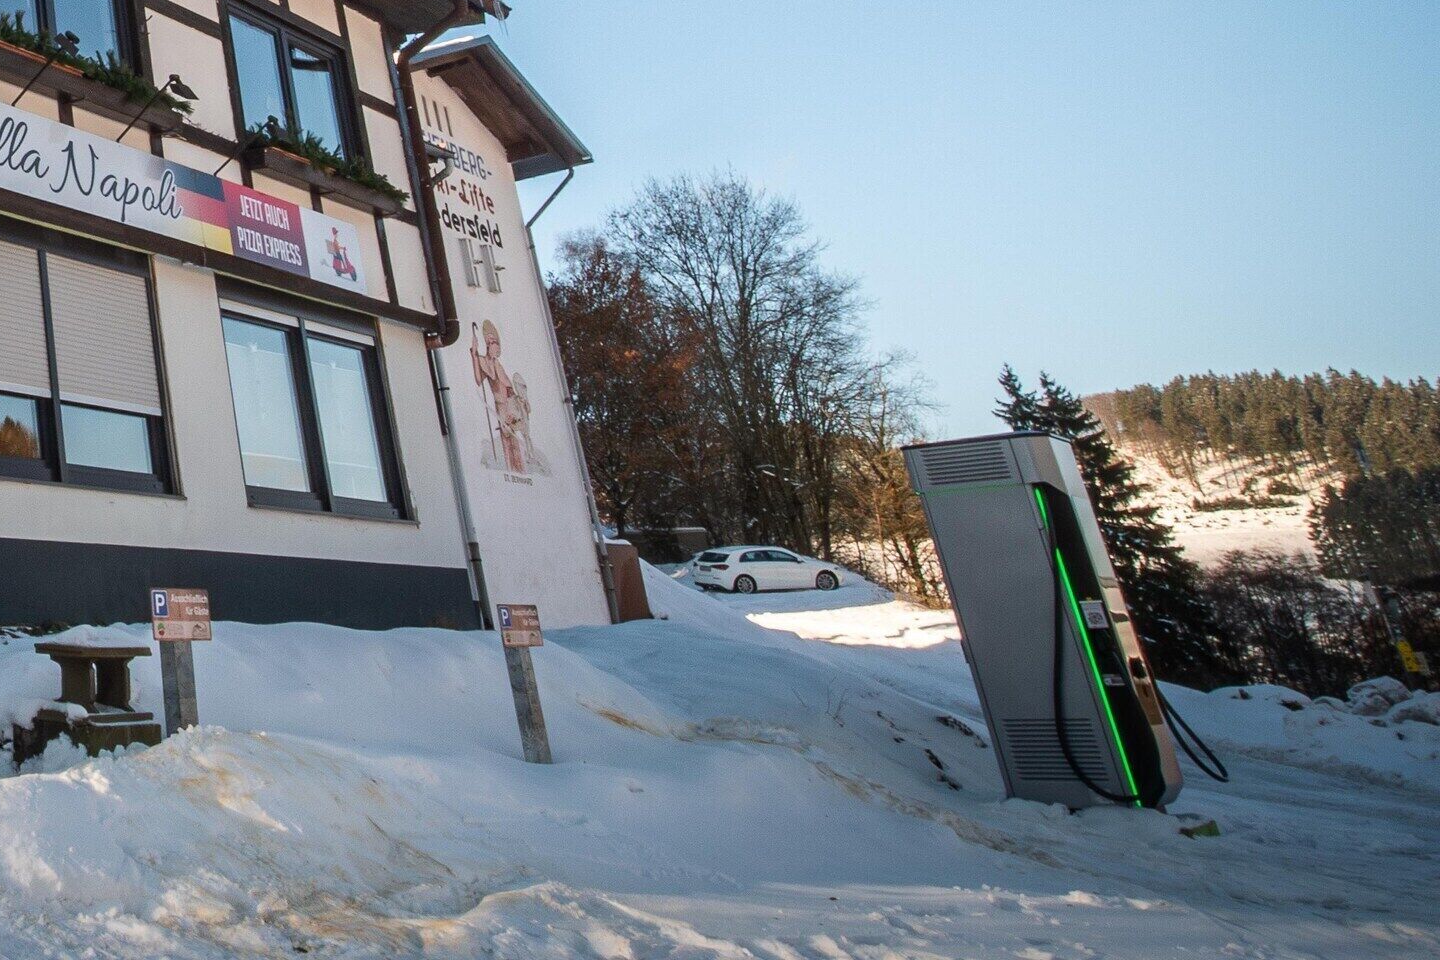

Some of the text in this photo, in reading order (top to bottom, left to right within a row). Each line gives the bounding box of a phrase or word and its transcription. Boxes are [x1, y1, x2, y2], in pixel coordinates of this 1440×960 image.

[50, 141, 183, 221] Napoli
[240, 195, 290, 230] JETZT AUCH
[439, 202, 503, 248] dersfeld
[237, 226, 303, 266] PIZZA EXPRESS
[155, 594, 165, 613] P
[501, 608, 508, 625] P
